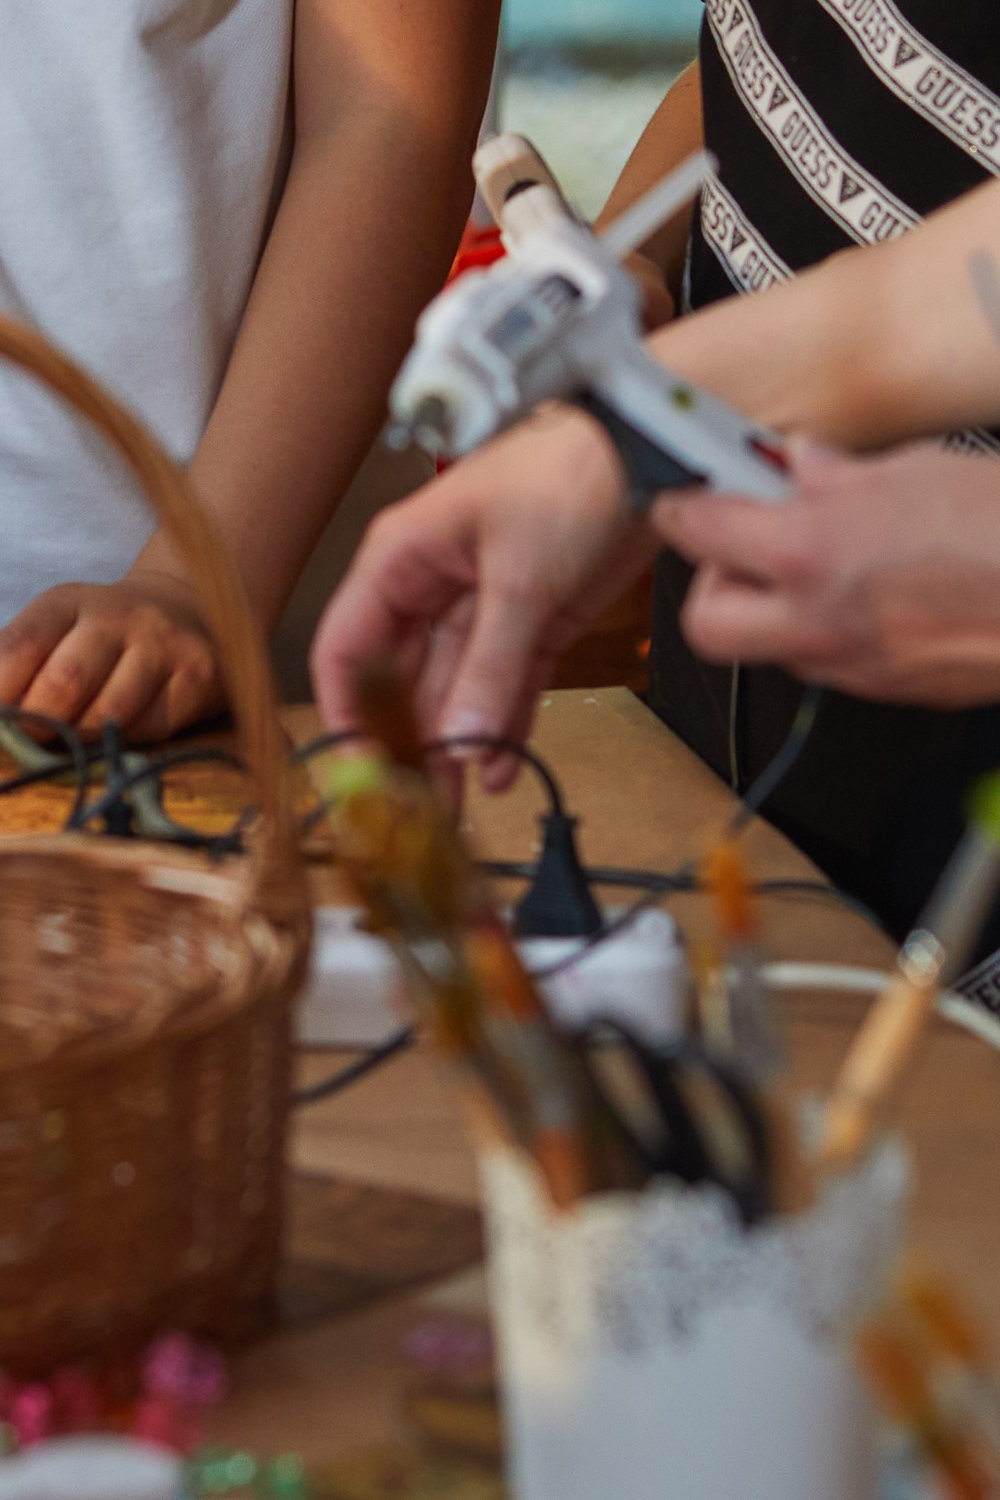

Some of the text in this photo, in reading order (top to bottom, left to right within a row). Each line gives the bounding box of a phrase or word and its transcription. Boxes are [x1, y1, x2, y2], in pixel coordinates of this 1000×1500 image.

[916, 66, 1000, 148] GUESS
[782, 111, 837, 189] GUESS
[861, 202, 909, 243] GU
